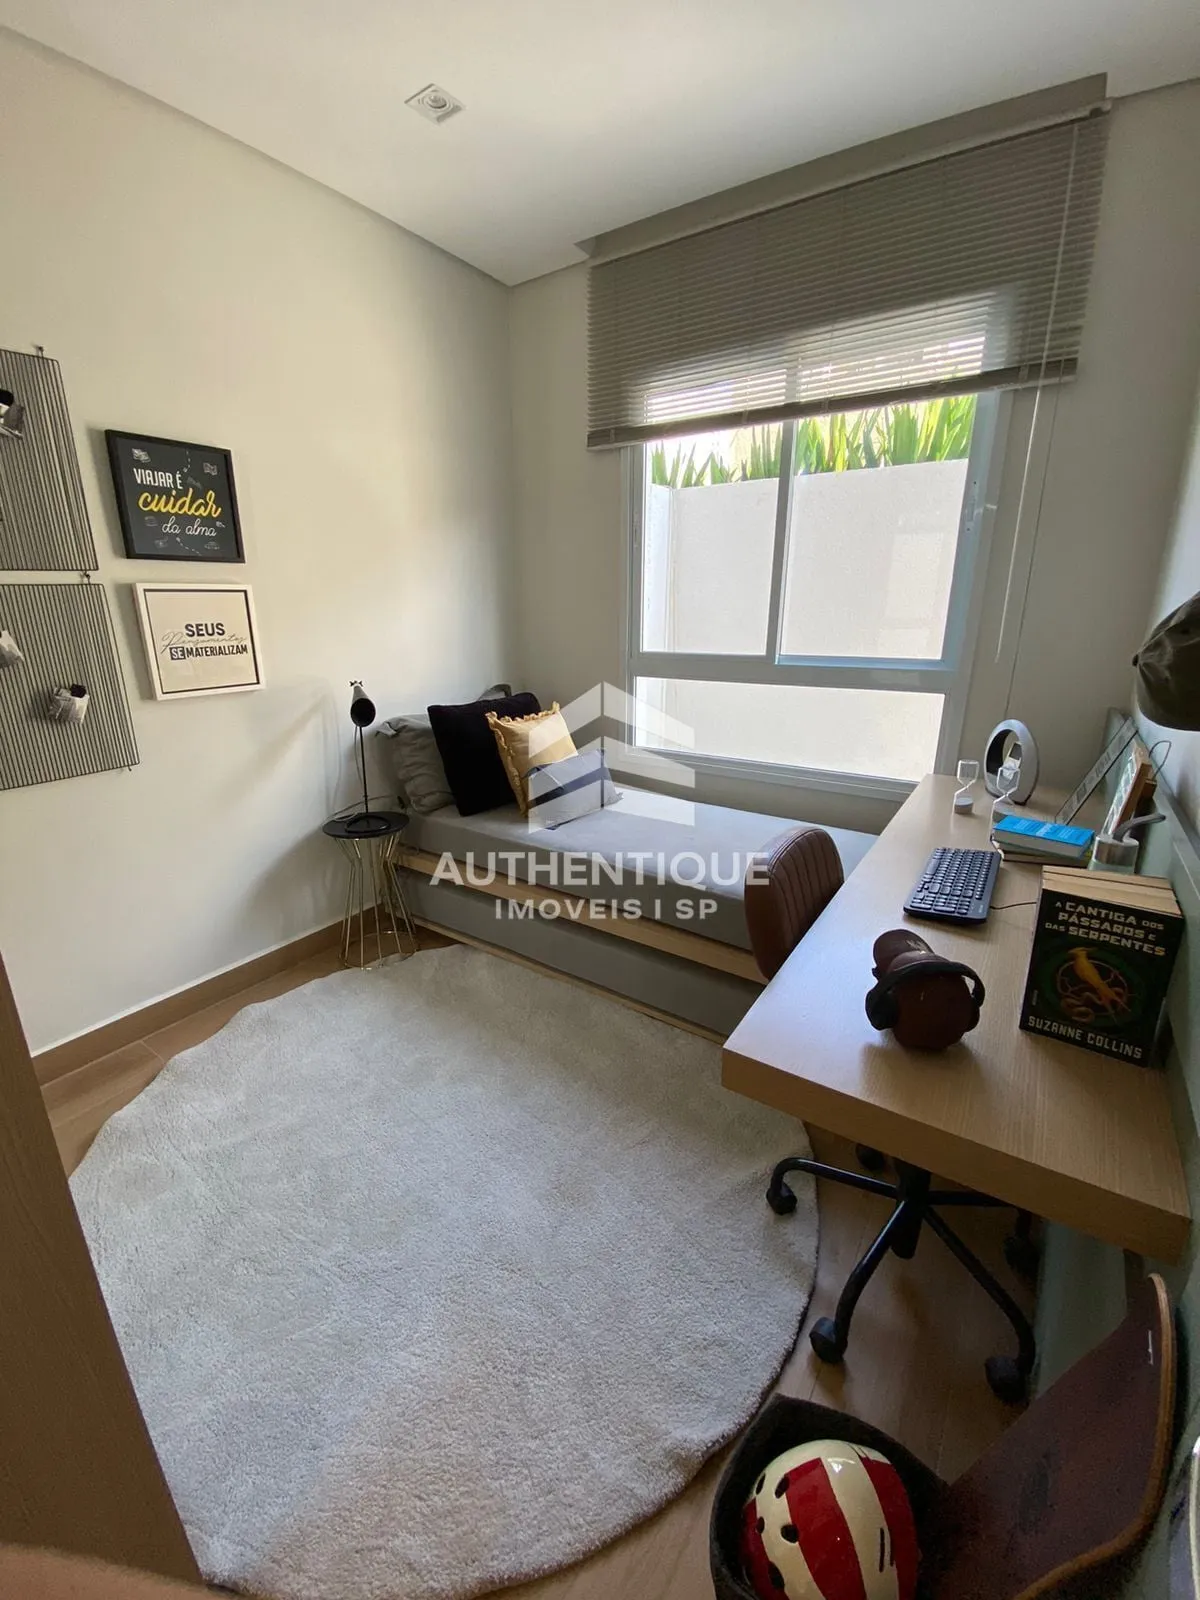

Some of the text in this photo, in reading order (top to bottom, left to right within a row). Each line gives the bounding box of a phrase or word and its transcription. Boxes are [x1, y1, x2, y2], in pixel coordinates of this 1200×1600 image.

[133, 467, 184, 490] VIAJAR É
[138, 487, 222, 518] cuidar
[161, 515, 217, 537] da alma
[184, 622, 226, 638] SEUS
[170, 644, 249, 660] SE MATERIALIZAM
[1058, 911, 1145, 939] PÁSSAROS
[1065, 901, 1137, 925] CANTIGA
[1142, 920, 1165, 931] DOS
[1045, 922, 1166, 957] DAS SERPENTES
[1028, 1015, 1143, 1060] SUZANNE COLLINS
